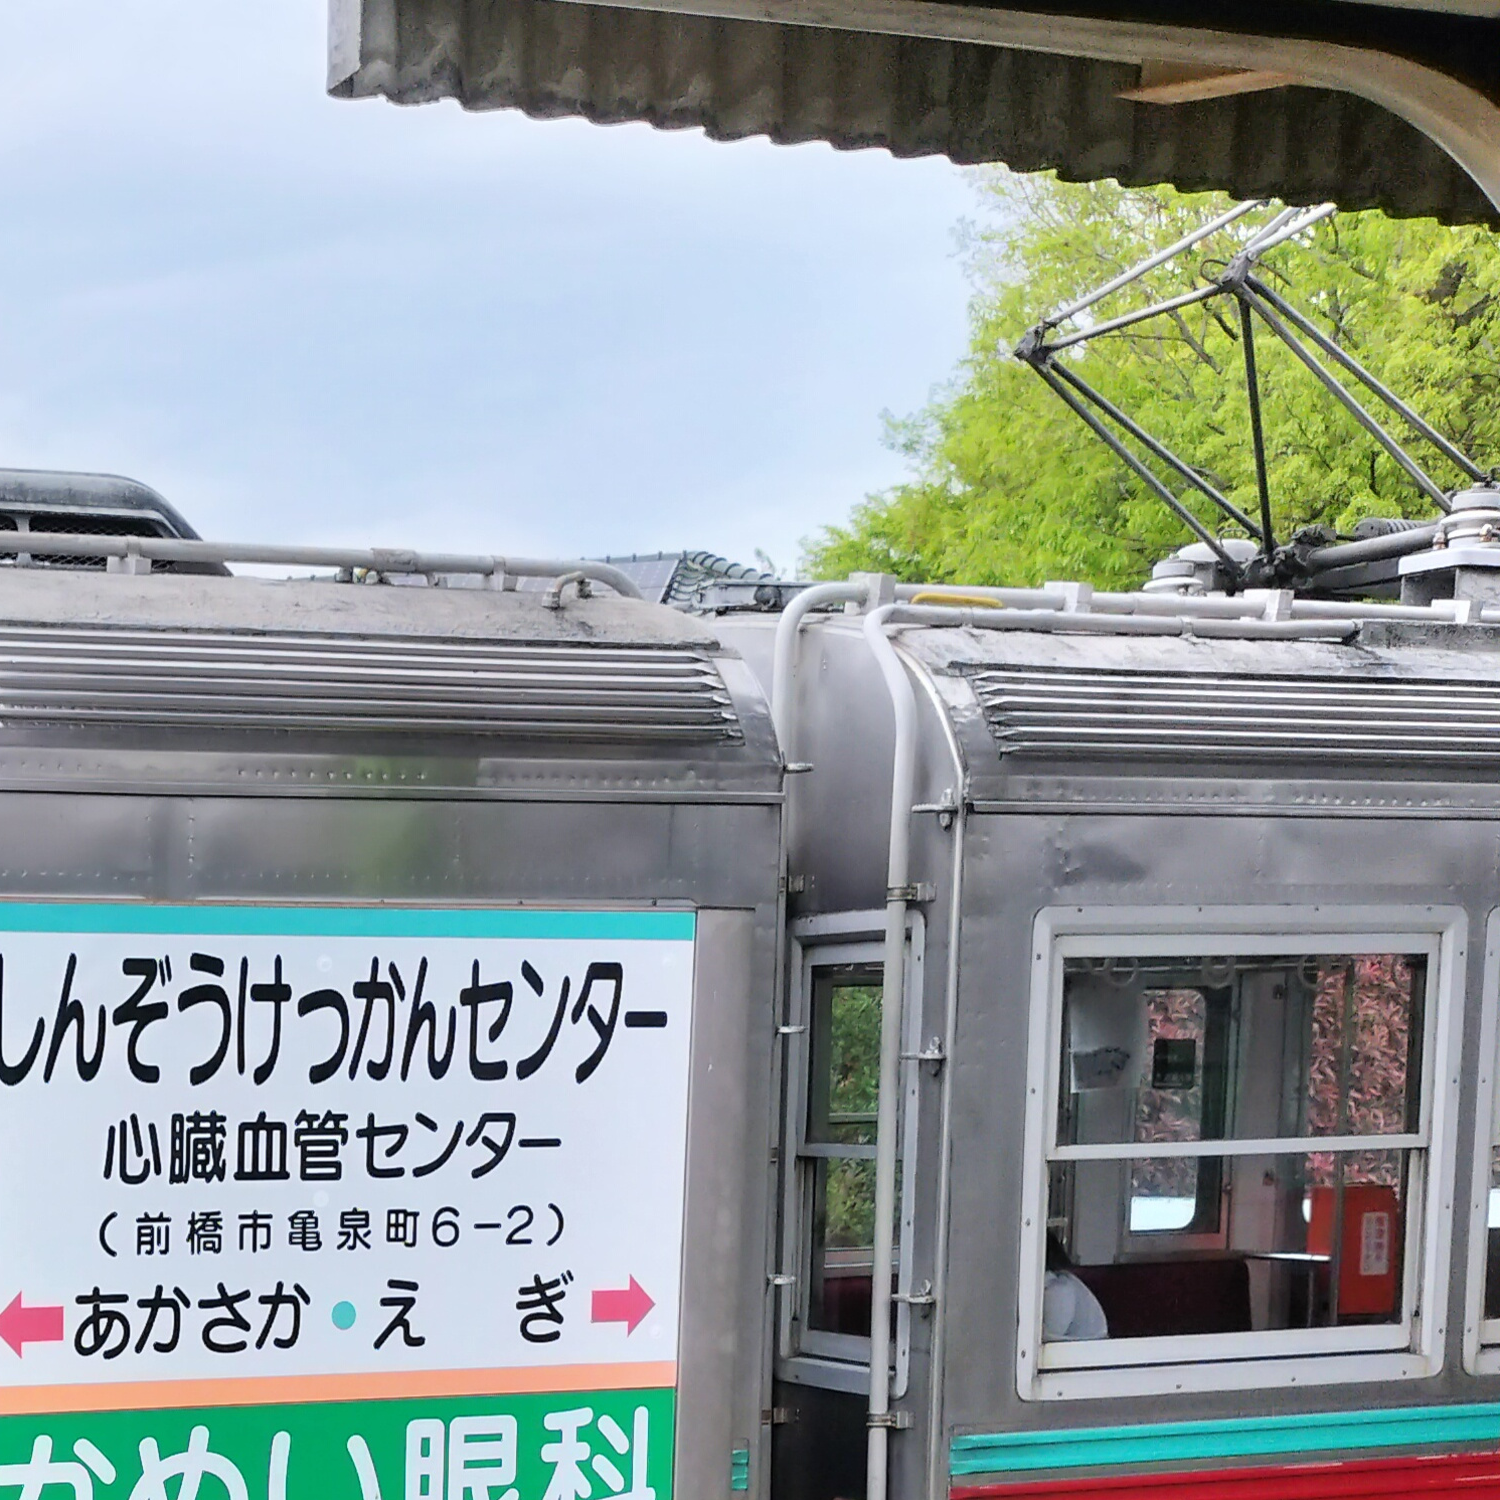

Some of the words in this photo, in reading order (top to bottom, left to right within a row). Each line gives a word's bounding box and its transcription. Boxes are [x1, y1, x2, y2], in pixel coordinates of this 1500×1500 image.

[103, 1110, 562, 1185] 心臓血管センター
[73, 1282, 311, 1361] あかさか
